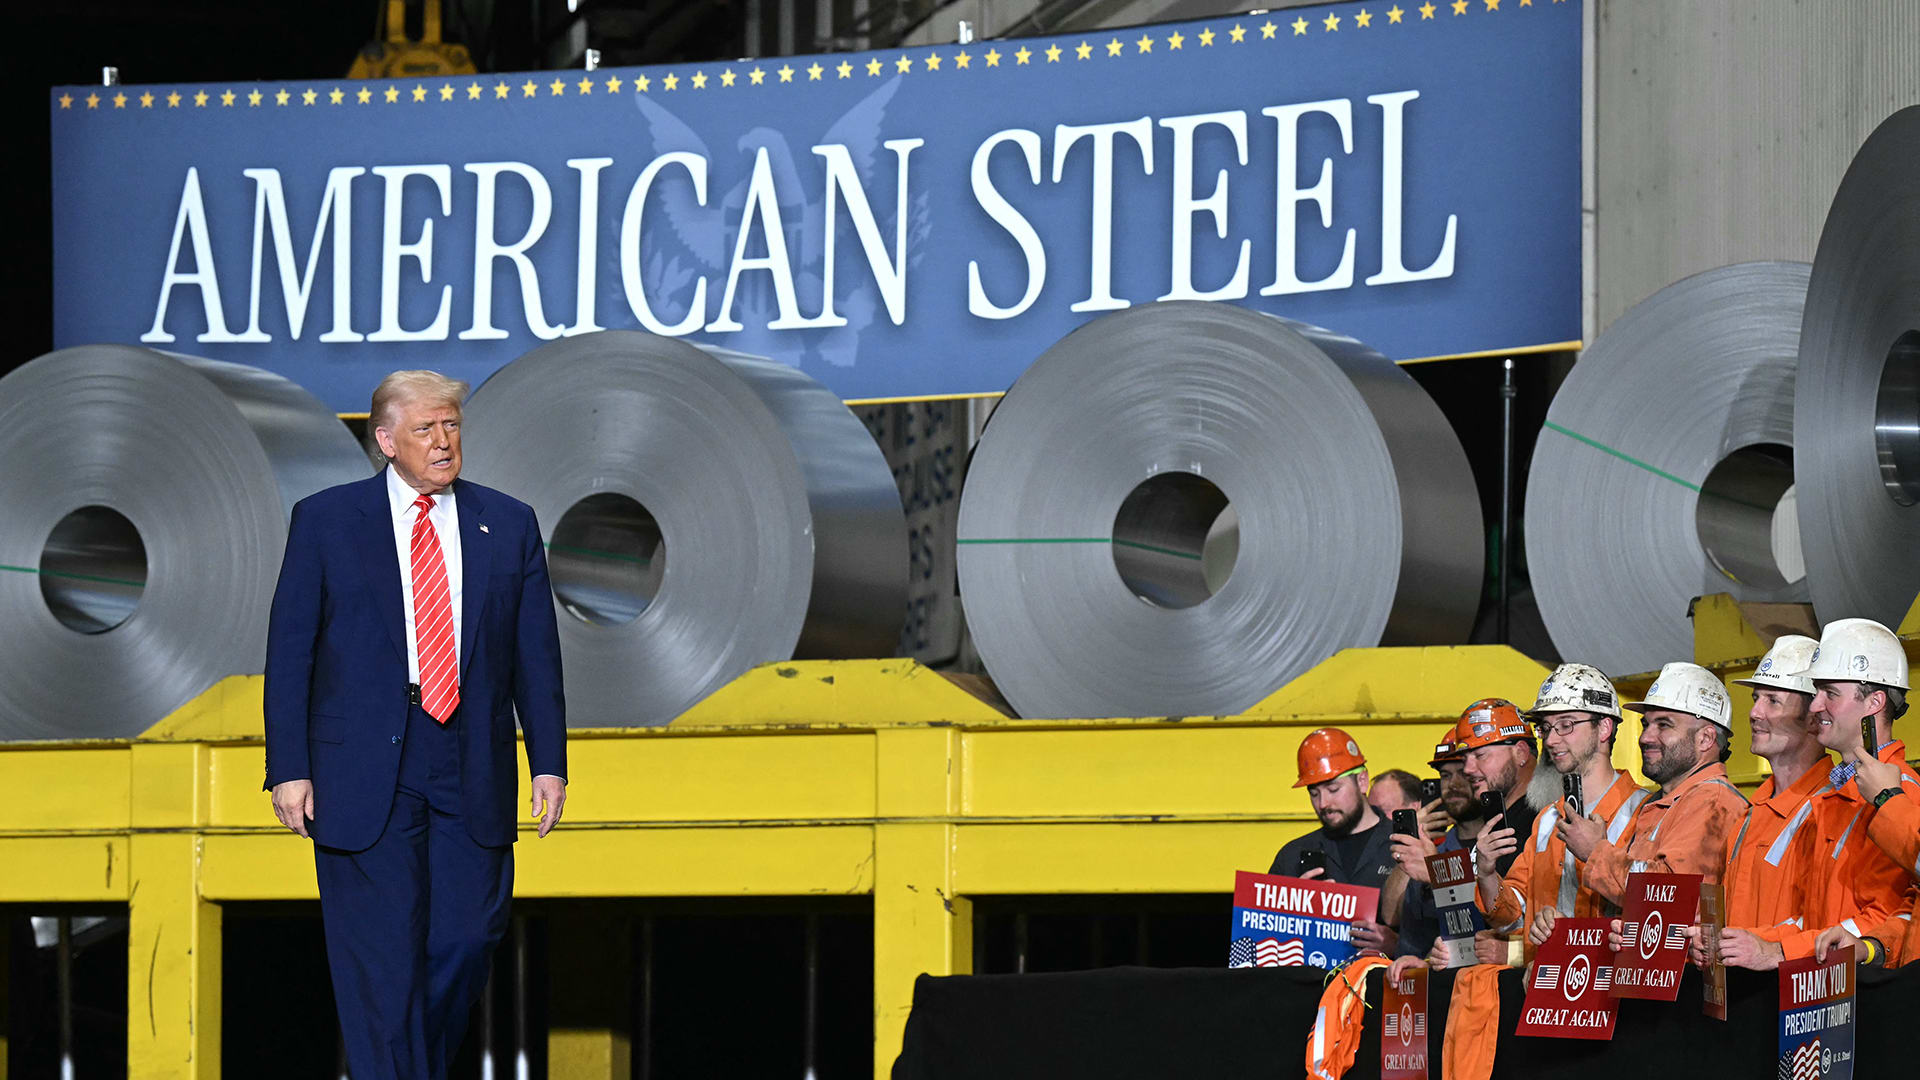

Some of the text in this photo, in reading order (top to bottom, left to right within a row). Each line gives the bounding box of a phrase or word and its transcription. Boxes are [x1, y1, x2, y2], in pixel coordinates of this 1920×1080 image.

[141, 90, 1458, 344] AMERICAN STEEL
[1432, 859, 1450, 884] STEEL
[1448, 856, 1465, 881] JOBS
[1254, 883, 1357, 919] THANK YOU
[1643, 885, 1677, 902] MAKE
[1242, 911, 1354, 942] PRESIDENT TRUM
[1445, 908, 1474, 935] REAL JOBS
[1565, 929, 1603, 946] MAKE
[1643, 924, 1660, 948] USS
[1398, 979, 1415, 996] MAKE
[1567, 966, 1587, 990] USS
[1614, 967, 1677, 988] GREAT AGAIN
[1791, 962, 1847, 1003] THANK YOU
[1526, 1007, 1610, 1028] GREAT AGAIN
[1784, 1002, 1851, 1036] PRESIDENT TRUMP!
[1384, 1054, 1425, 1071] GREAT AGAIN
